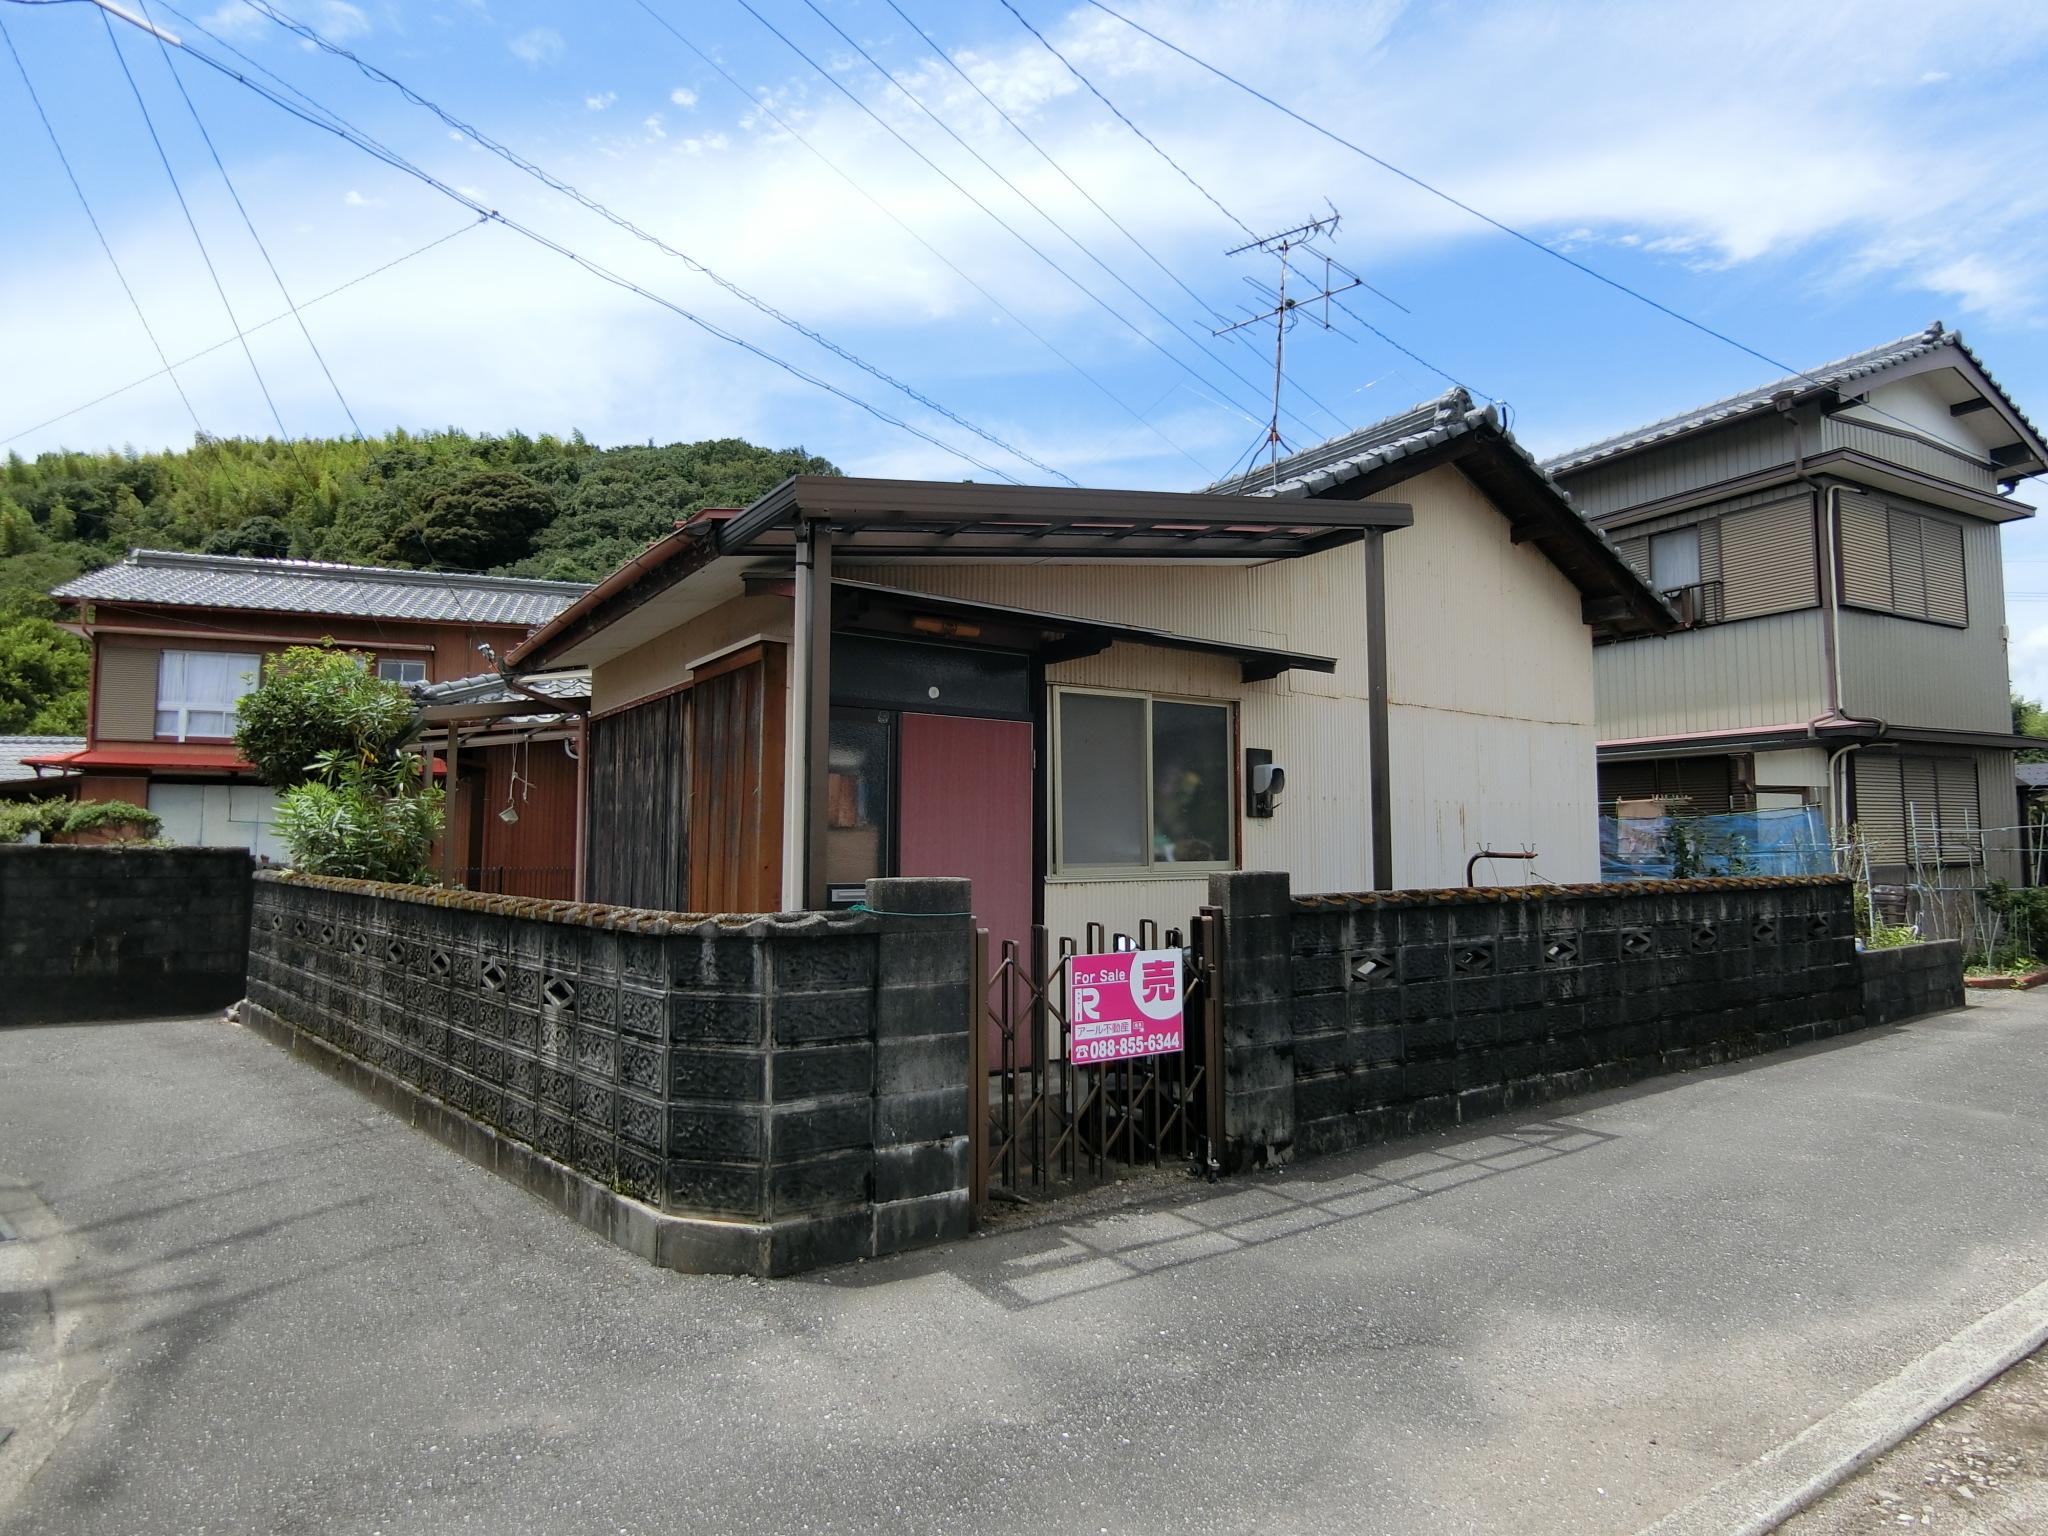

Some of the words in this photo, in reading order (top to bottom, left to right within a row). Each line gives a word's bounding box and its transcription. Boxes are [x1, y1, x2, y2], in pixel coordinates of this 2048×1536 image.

[1074, 971, 1096, 984] For
[1100, 968, 1126, 982] Sale
[1142, 960, 1175, 1003] 売
[1077, 1021, 1130, 1037] アール不動産
[1090, 1031, 1180, 1059] 088-855-6344
